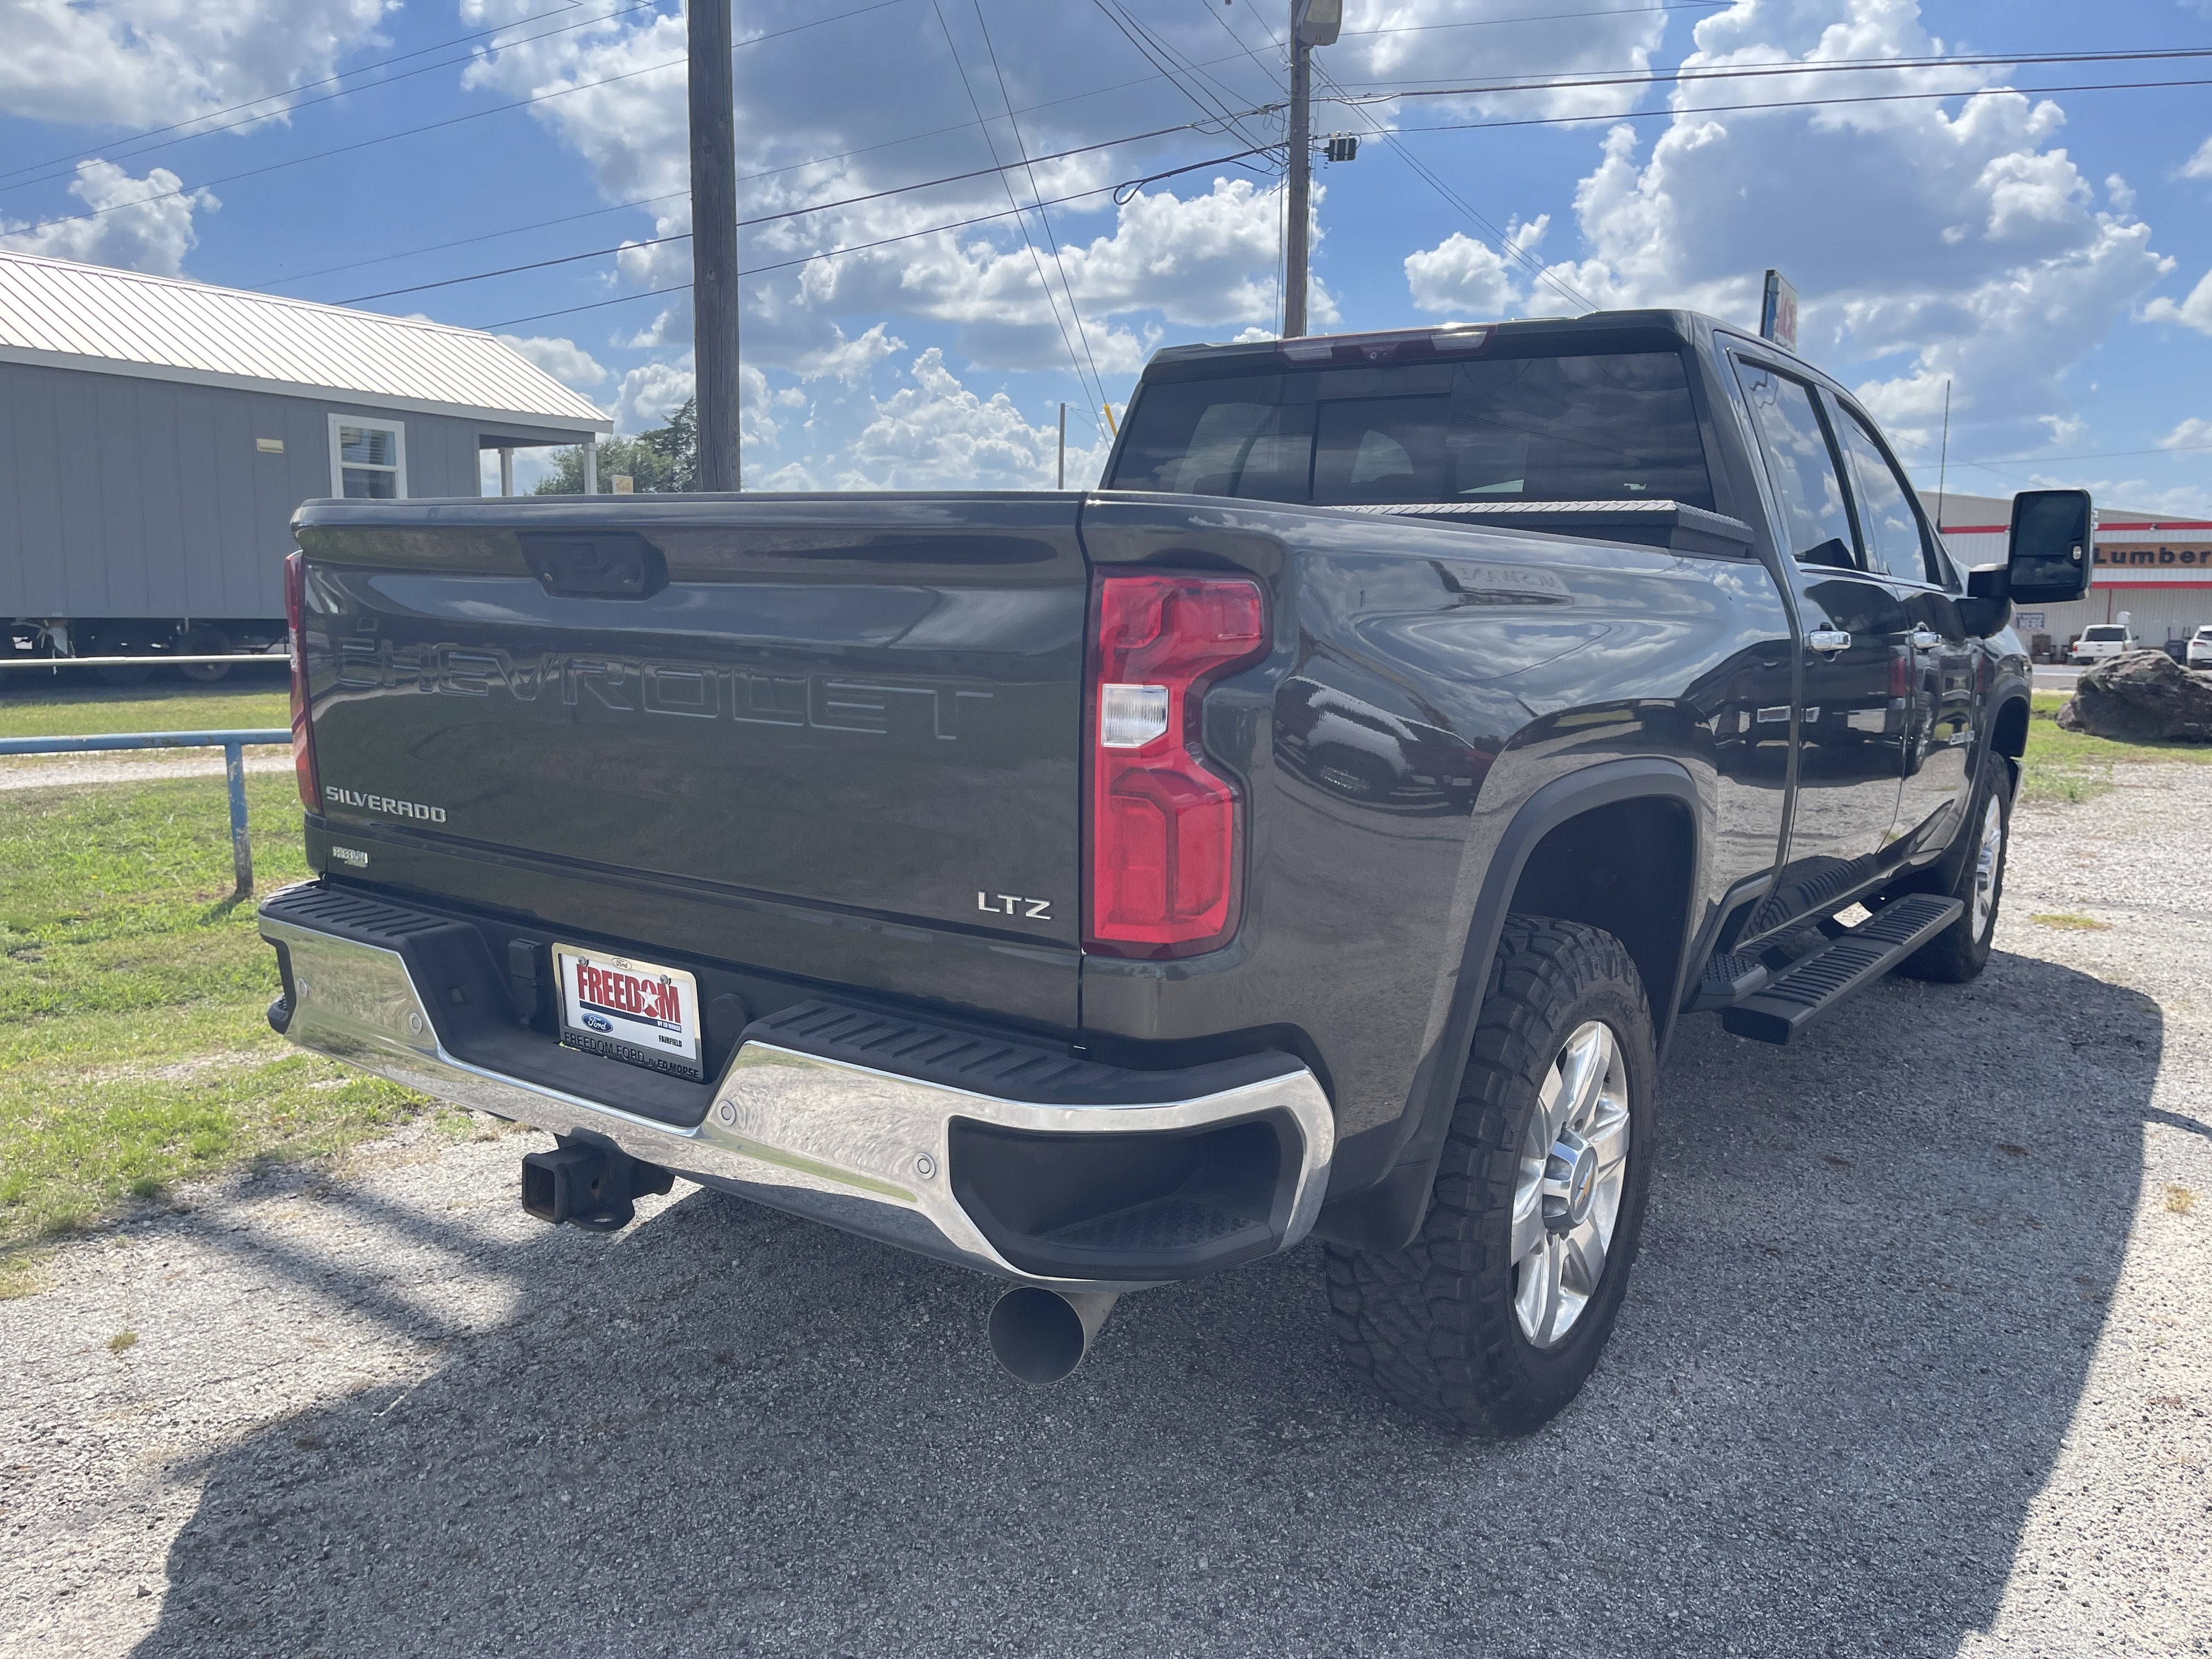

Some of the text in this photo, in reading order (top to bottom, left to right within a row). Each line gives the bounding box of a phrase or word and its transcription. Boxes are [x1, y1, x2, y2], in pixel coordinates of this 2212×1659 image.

[2094, 546, 2212, 564] Lumber
[336, 635, 995, 741] CHEVROLET
[326, 786, 447, 823] SILVERADO
[978, 891, 1051, 920] LTZ
[616, 960, 628, 968] Ford
[577, 964, 681, 1024] FREEDOM
[588, 1016, 607, 1030] Ford
[565, 1032, 614, 1057] FREEDOM
[617, 1045, 645, 1064] FORD
[658, 1058, 668, 1071] ED
[669, 1060, 699, 1078] MORSE
[658, 1035, 682, 1048] FAIRFIELD
